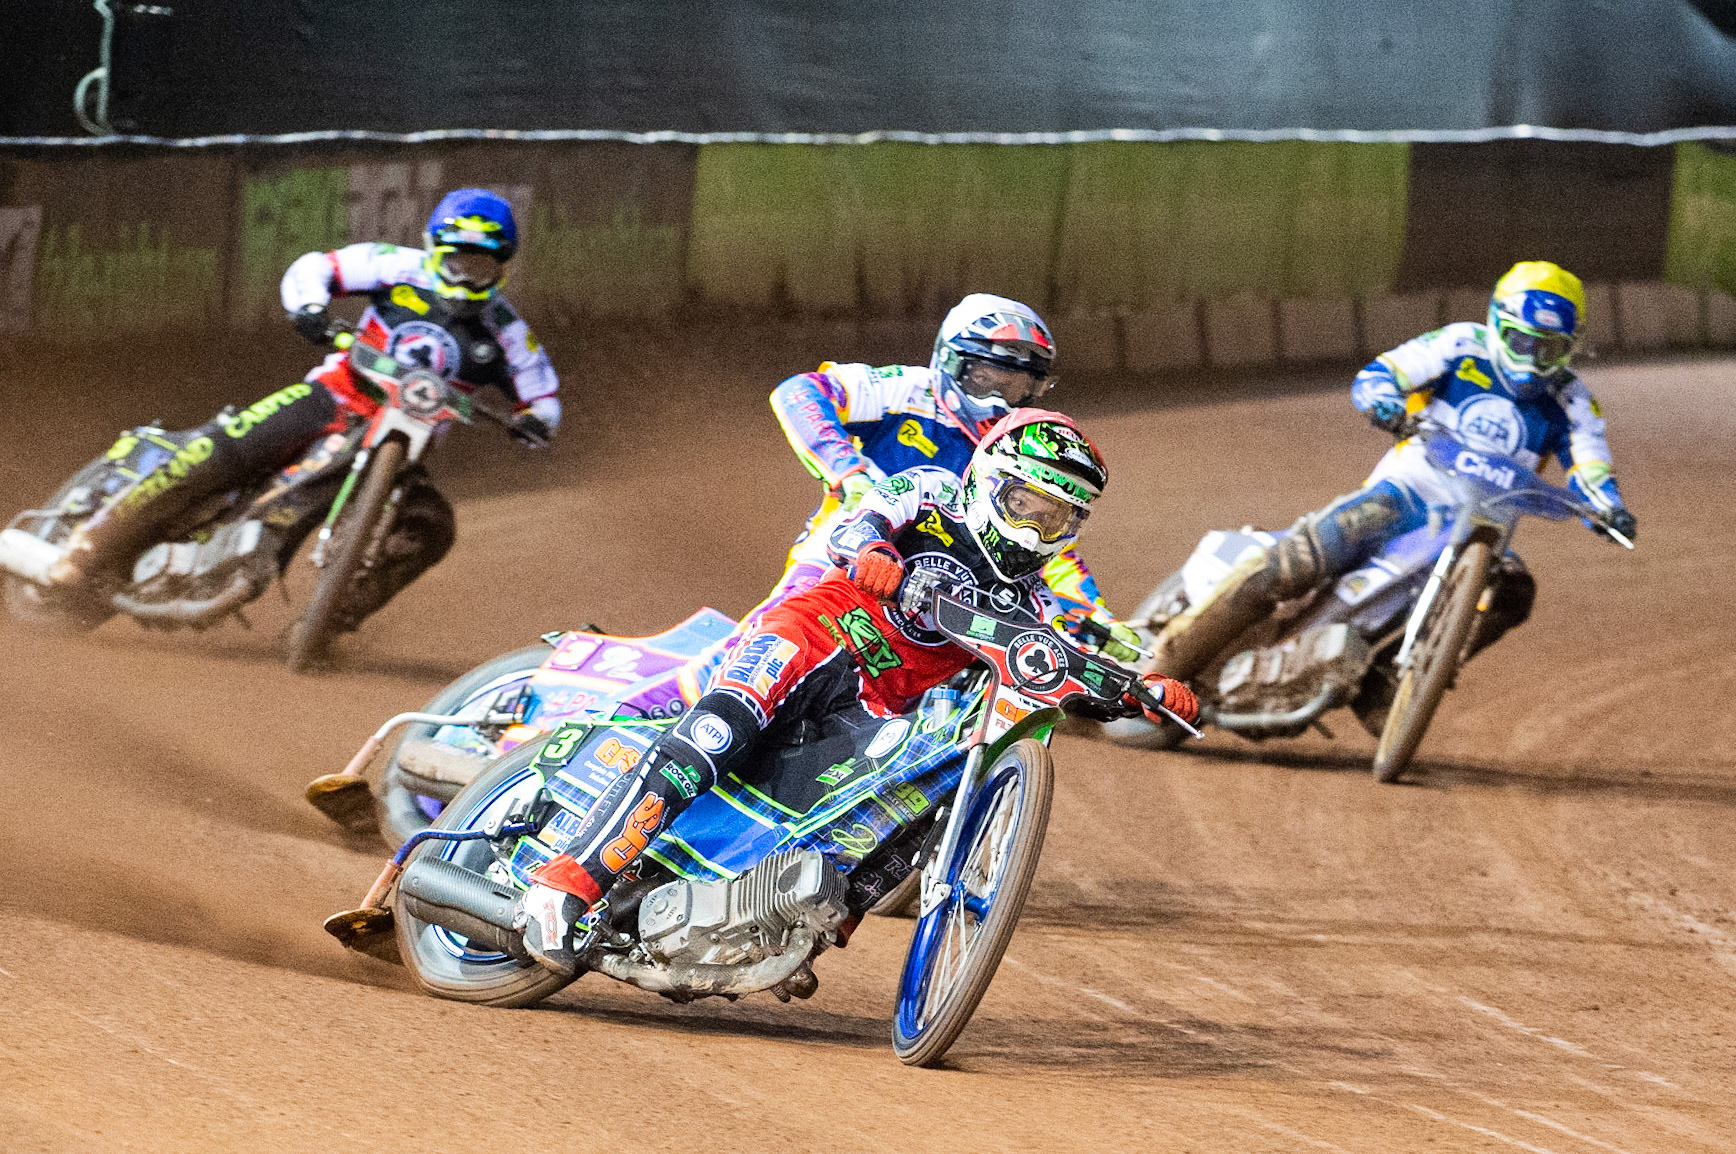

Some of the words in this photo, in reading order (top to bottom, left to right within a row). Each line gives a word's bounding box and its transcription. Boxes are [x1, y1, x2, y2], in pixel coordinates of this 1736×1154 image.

[1455, 450, 1516, 490] Civil
[914, 556, 951, 568] BELLE
[727, 634, 778, 684] ALBON
[1013, 634, 1036, 649] BELLE
[1038, 635, 1054, 647] VUE
[1054, 648, 1065, 668] ACES
[766, 658, 784, 680] plc
[544, 728, 584, 759] 3
[699, 722, 725, 744] ATPI
[665, 763, 686, 785] ROCK
[684, 782, 696, 797] OIL
[550, 811, 581, 837] ALB
[601, 791, 666, 873] CFS
